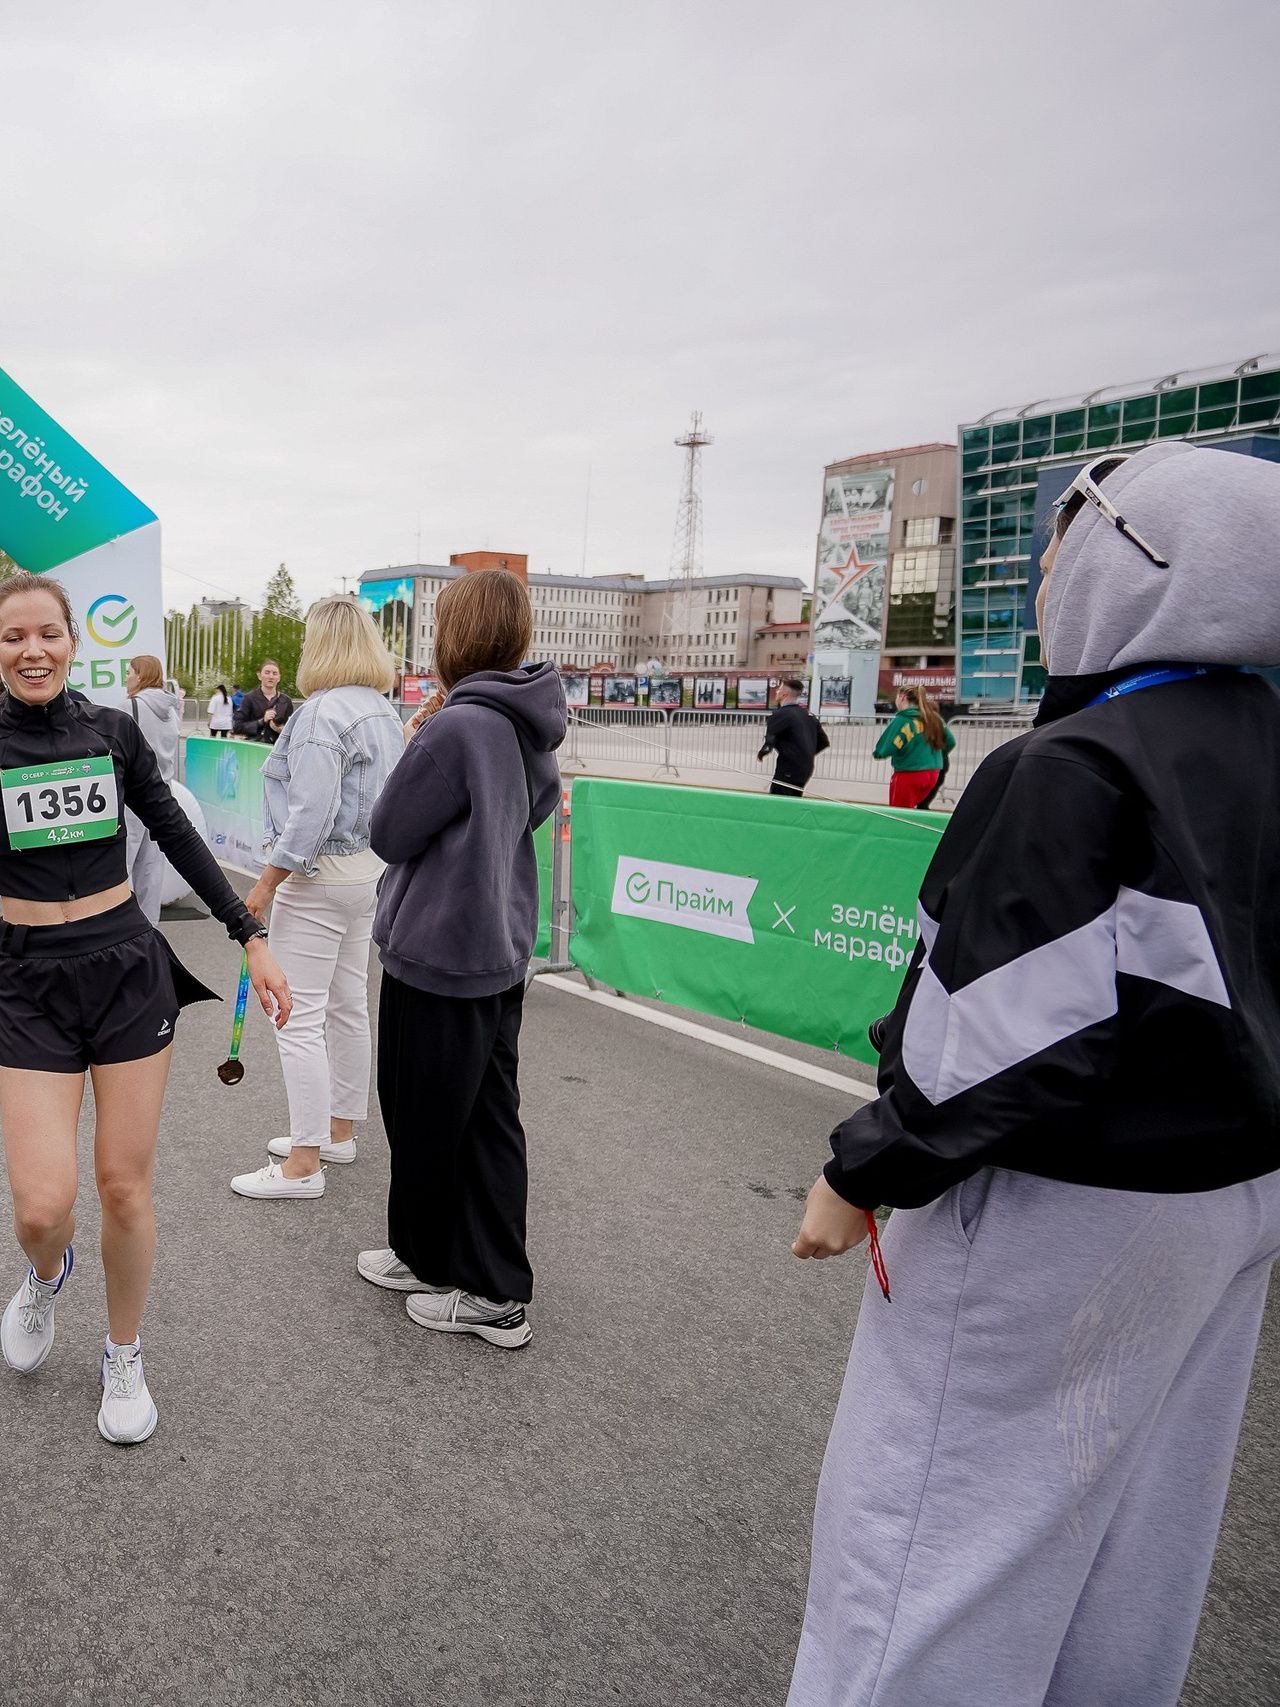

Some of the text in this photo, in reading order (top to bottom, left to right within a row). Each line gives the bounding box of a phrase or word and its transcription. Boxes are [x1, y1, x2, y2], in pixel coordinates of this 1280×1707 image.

[893, 672, 956, 687] Мемориальна
[16, 782, 107, 823] 1356
[656, 880, 734, 917] Прайм
[831, 903, 922, 941] зелён
[814, 928, 914, 972] мараф
